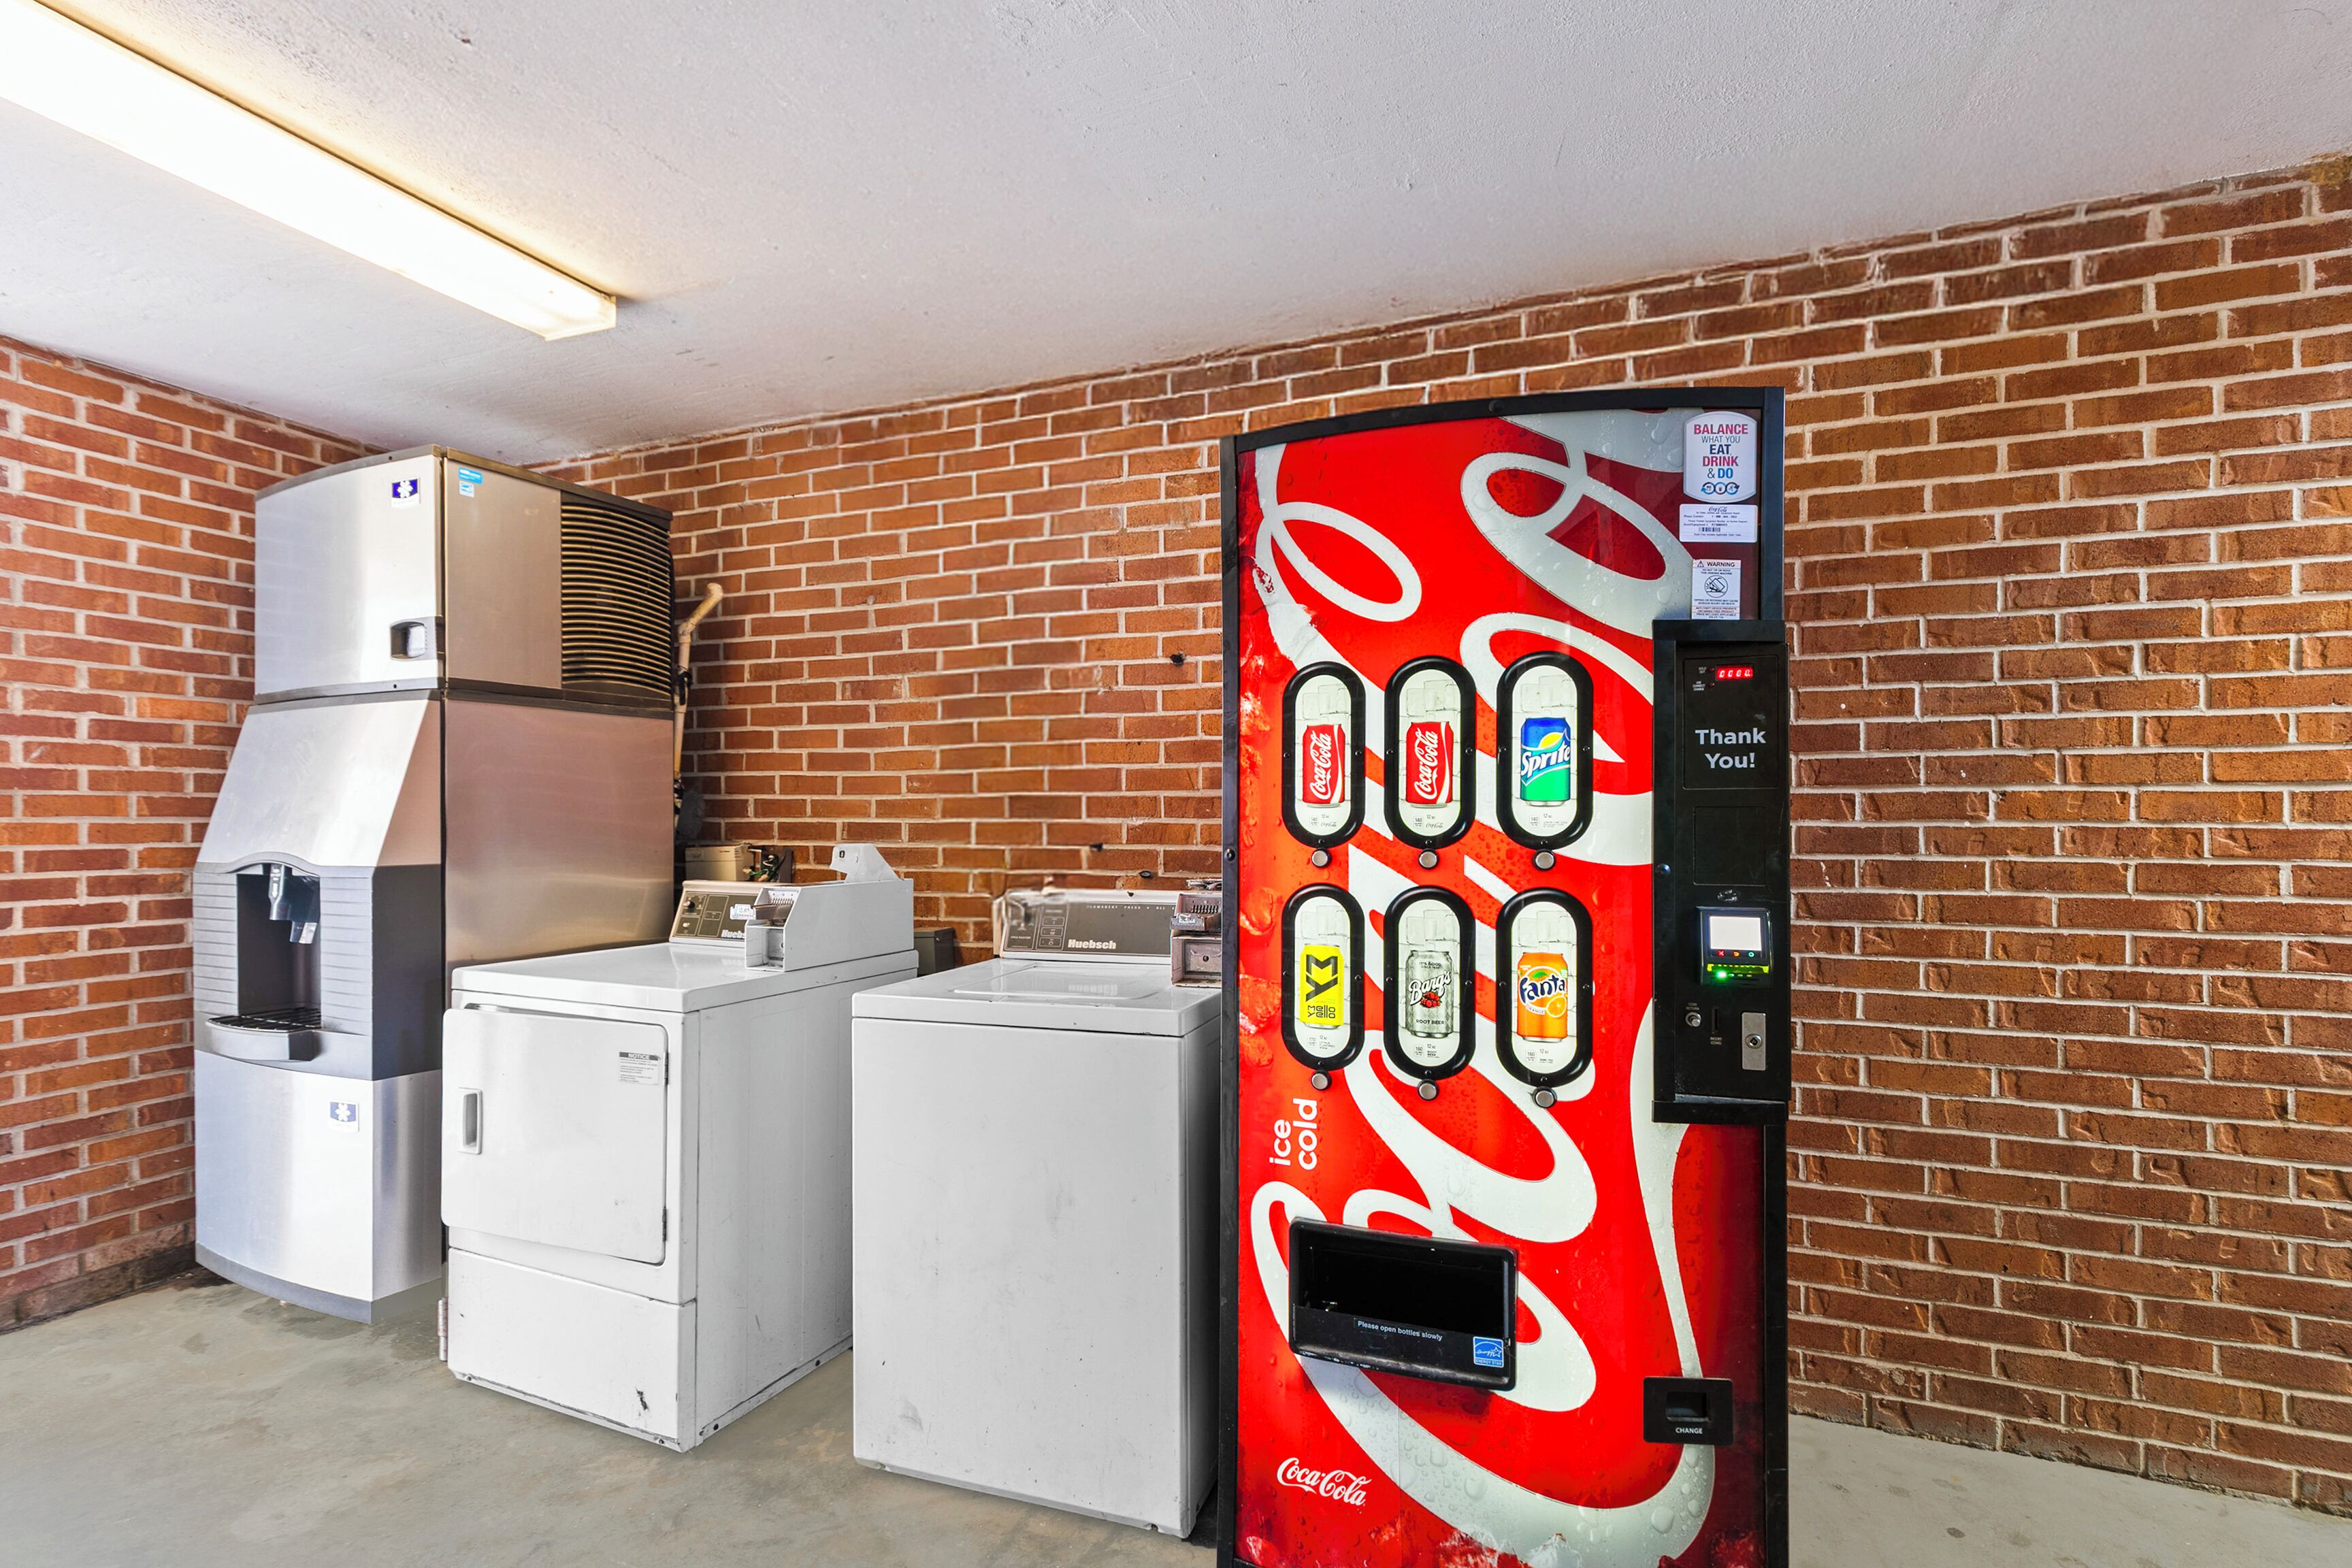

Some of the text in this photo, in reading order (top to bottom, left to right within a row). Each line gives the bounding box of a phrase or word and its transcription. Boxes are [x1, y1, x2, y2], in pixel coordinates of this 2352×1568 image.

[1693, 423, 1748, 435] BALANCE
[1701, 436, 1741, 444] WHAT YOU
[1703, 456, 1739, 467] DRINK
[1707, 468, 1733, 479] & DO
[1695, 727, 1767, 745] Thank
[1309, 730, 1332, 800] Coca-Cola
[1414, 727, 1438, 800] Coca-Cola
[1520, 740, 1571, 779] Sprite
[1705, 752, 1755, 769] You!
[1068, 938, 1116, 950] Huebsch
[1269, 1119, 1291, 1166] ice
[1292, 1098, 1318, 1171] cold
[1358, 1320, 1443, 1342] Please open bottles slowly
[1276, 1457, 1372, 1506] Coca-Cola
